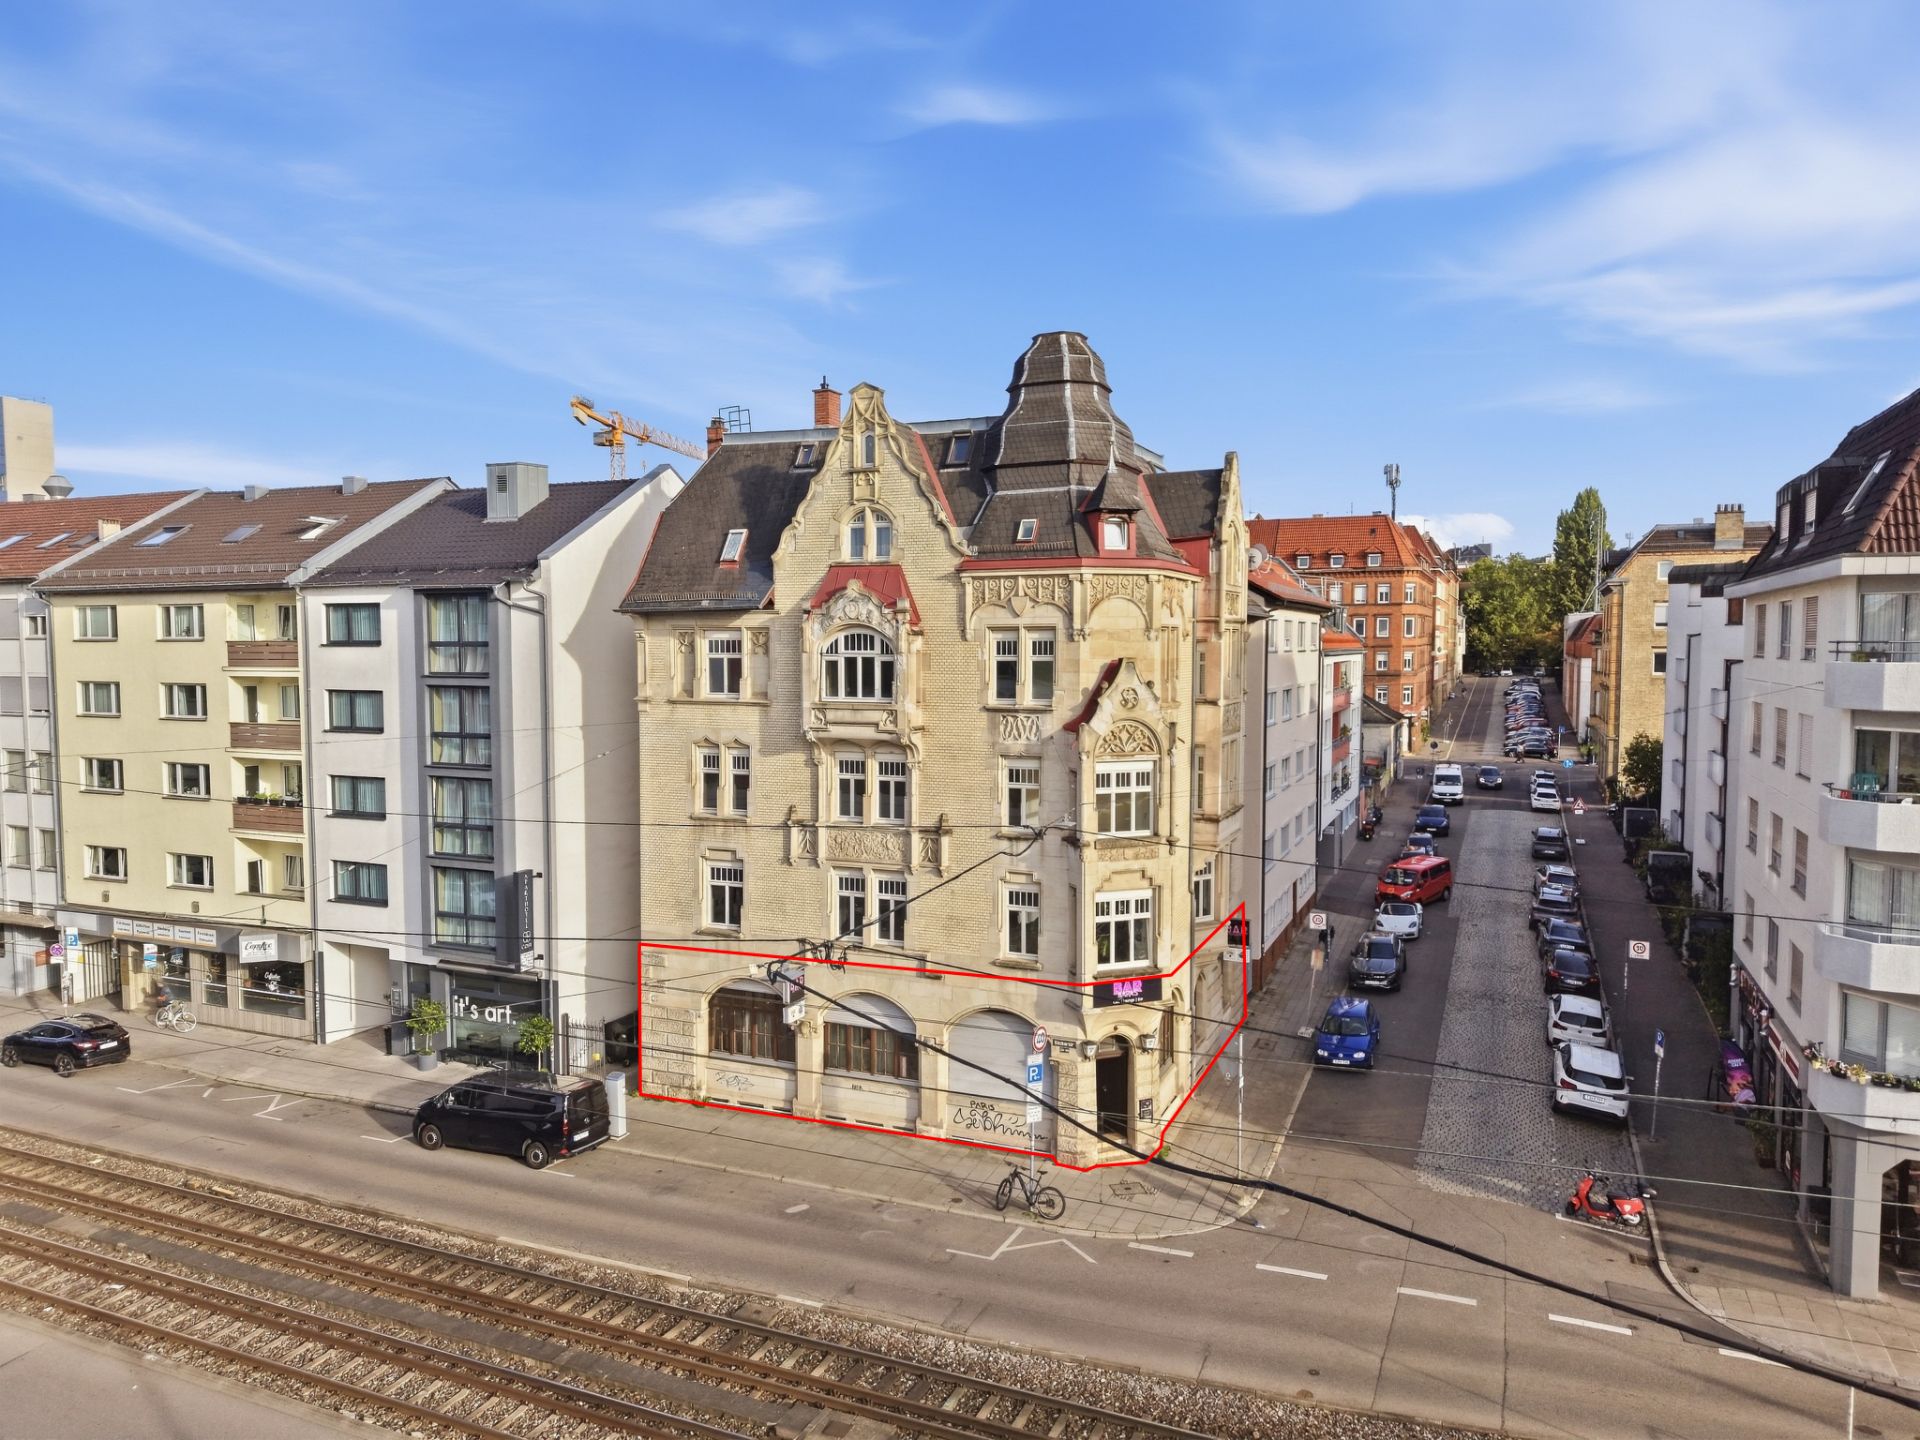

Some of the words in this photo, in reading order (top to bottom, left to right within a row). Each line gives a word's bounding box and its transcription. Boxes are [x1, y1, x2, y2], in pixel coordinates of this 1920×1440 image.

[1113, 979, 1143, 996] BAR
[455, 995, 479, 1020] it's
[485, 1005, 517, 1025] art.
[1029, 1066, 1039, 1081] P
